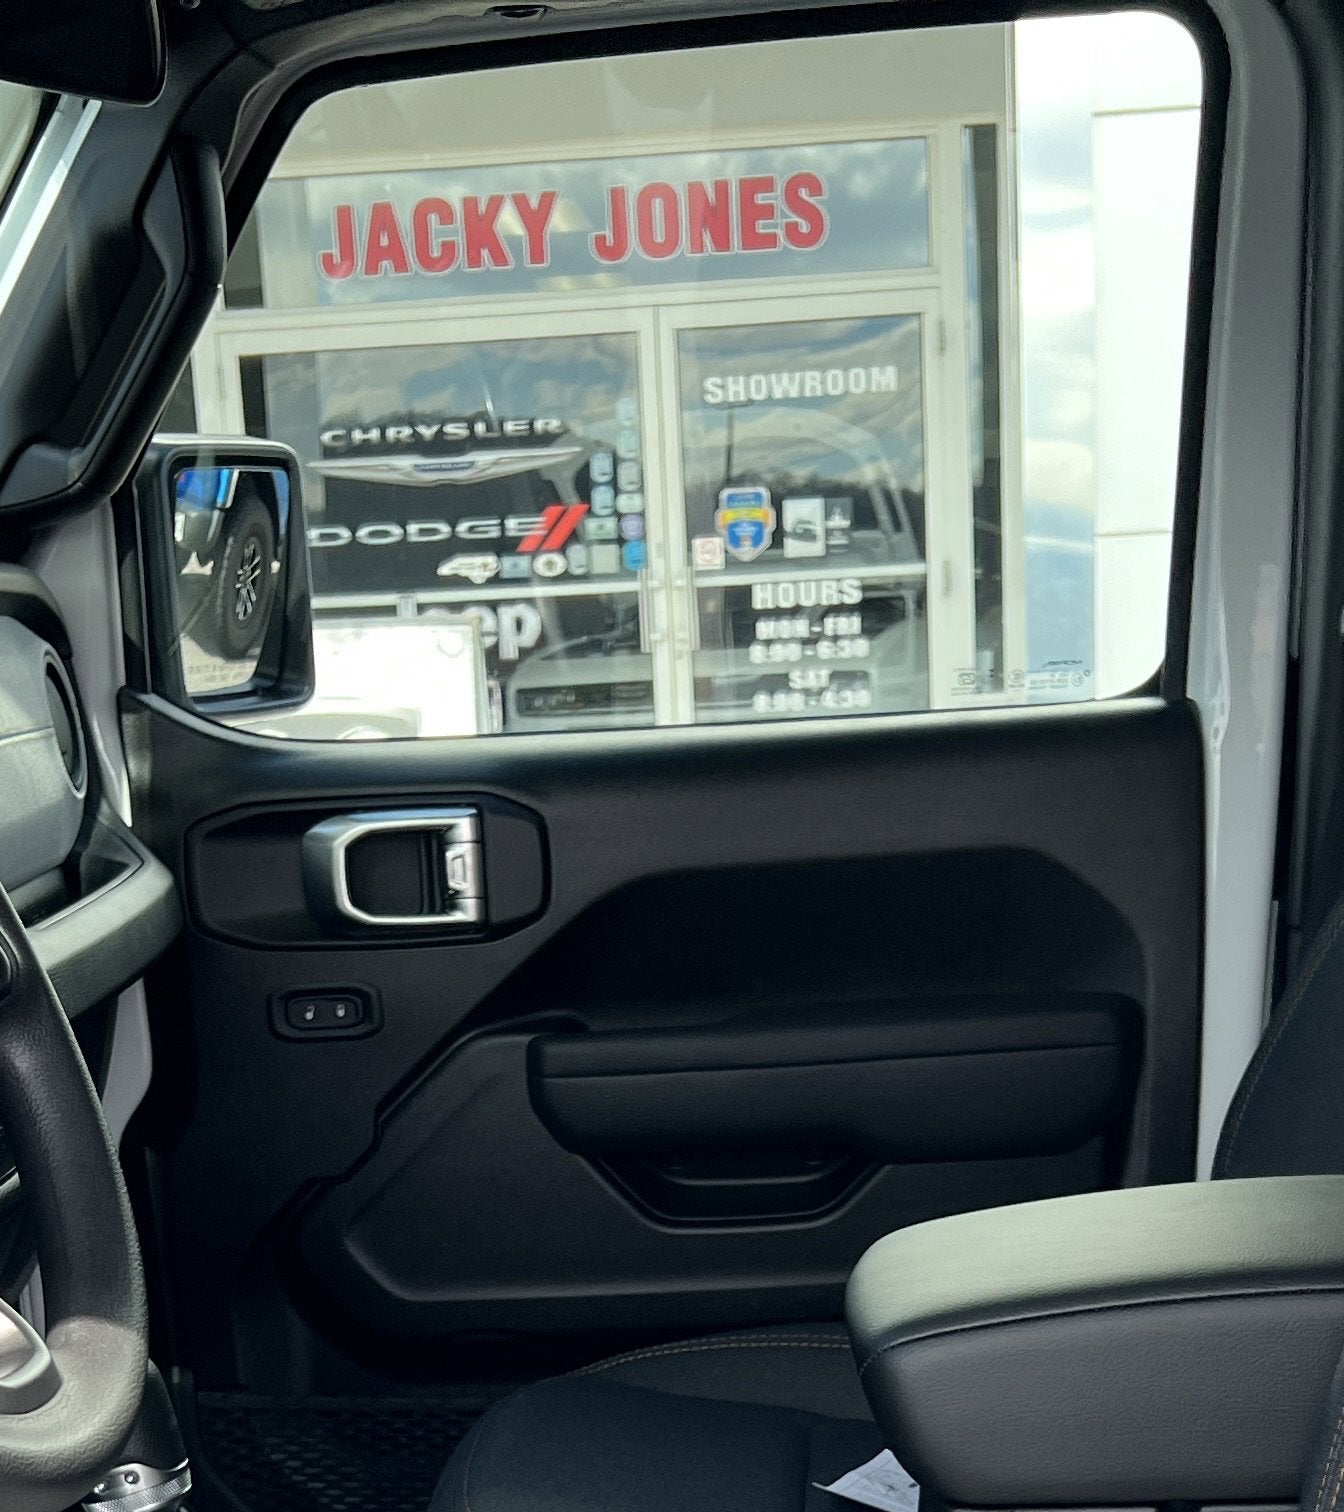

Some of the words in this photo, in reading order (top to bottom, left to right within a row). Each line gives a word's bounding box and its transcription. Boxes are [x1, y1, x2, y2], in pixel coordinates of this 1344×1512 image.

[319, 189, 559, 281] JACKY
[588, 171, 831, 265] JONES
[702, 366, 898, 403] SHOWROOM
[320, 417, 562, 447] CHRYSLER
[306, 514, 548, 547] DODGE
[751, 578, 863, 610] HOURS
[788, 668, 832, 689] SAT
